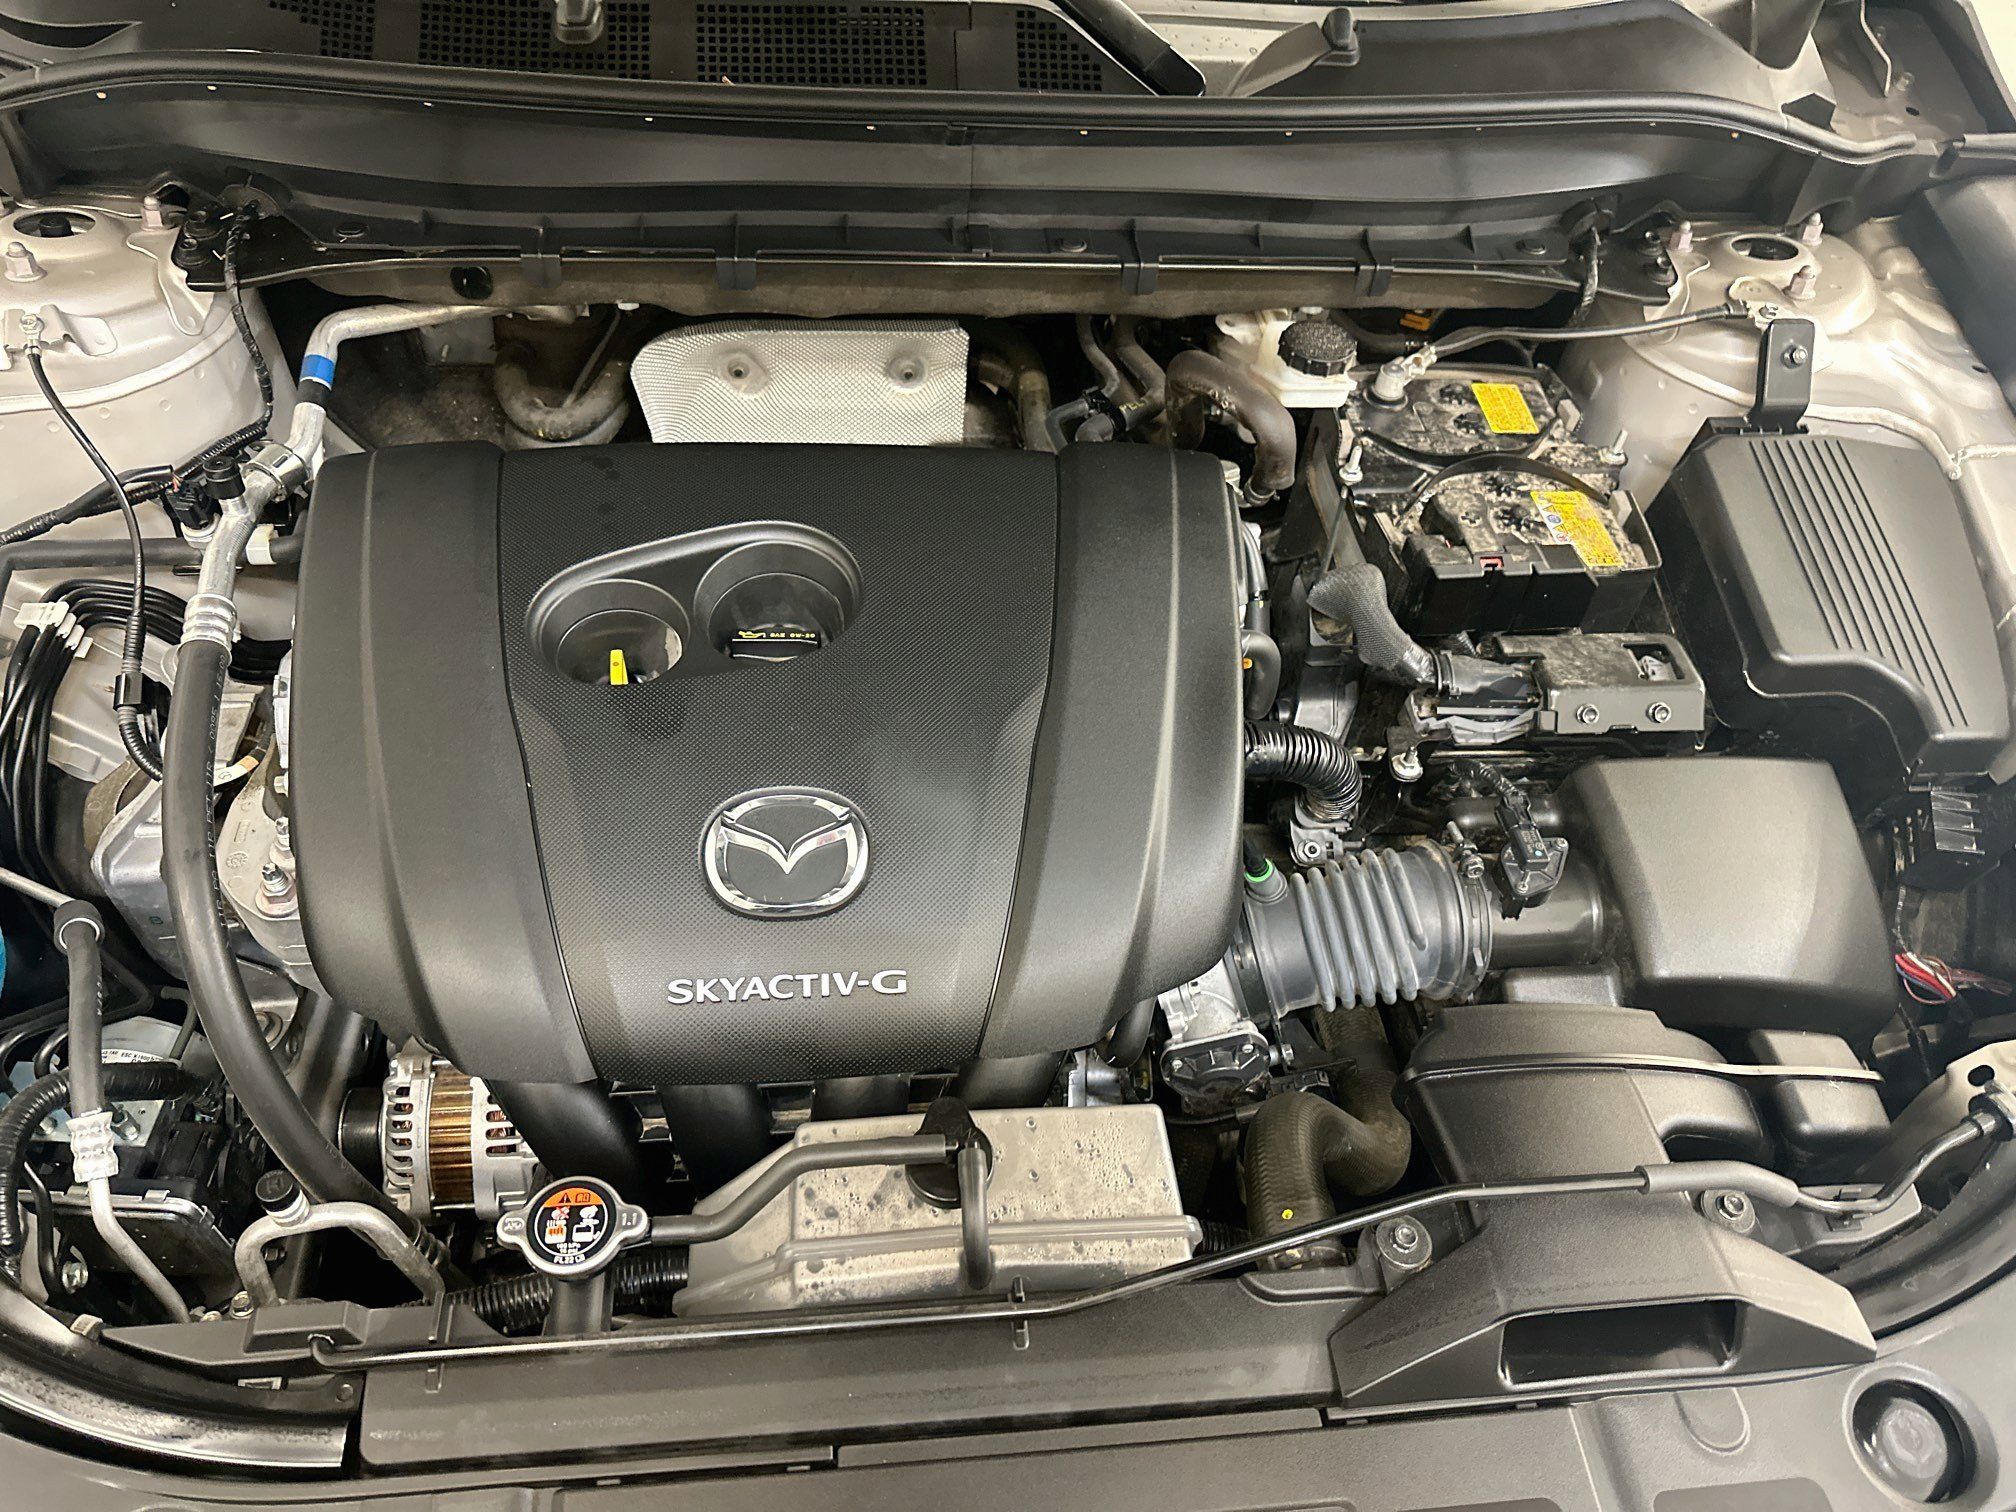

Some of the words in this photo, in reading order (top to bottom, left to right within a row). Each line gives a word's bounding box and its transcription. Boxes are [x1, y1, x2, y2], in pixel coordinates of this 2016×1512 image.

[667, 969, 908, 1005] SKYACTIV-G
[622, 1212, 638, 1226] 1.1
[553, 1255, 574, 1264] FL22
